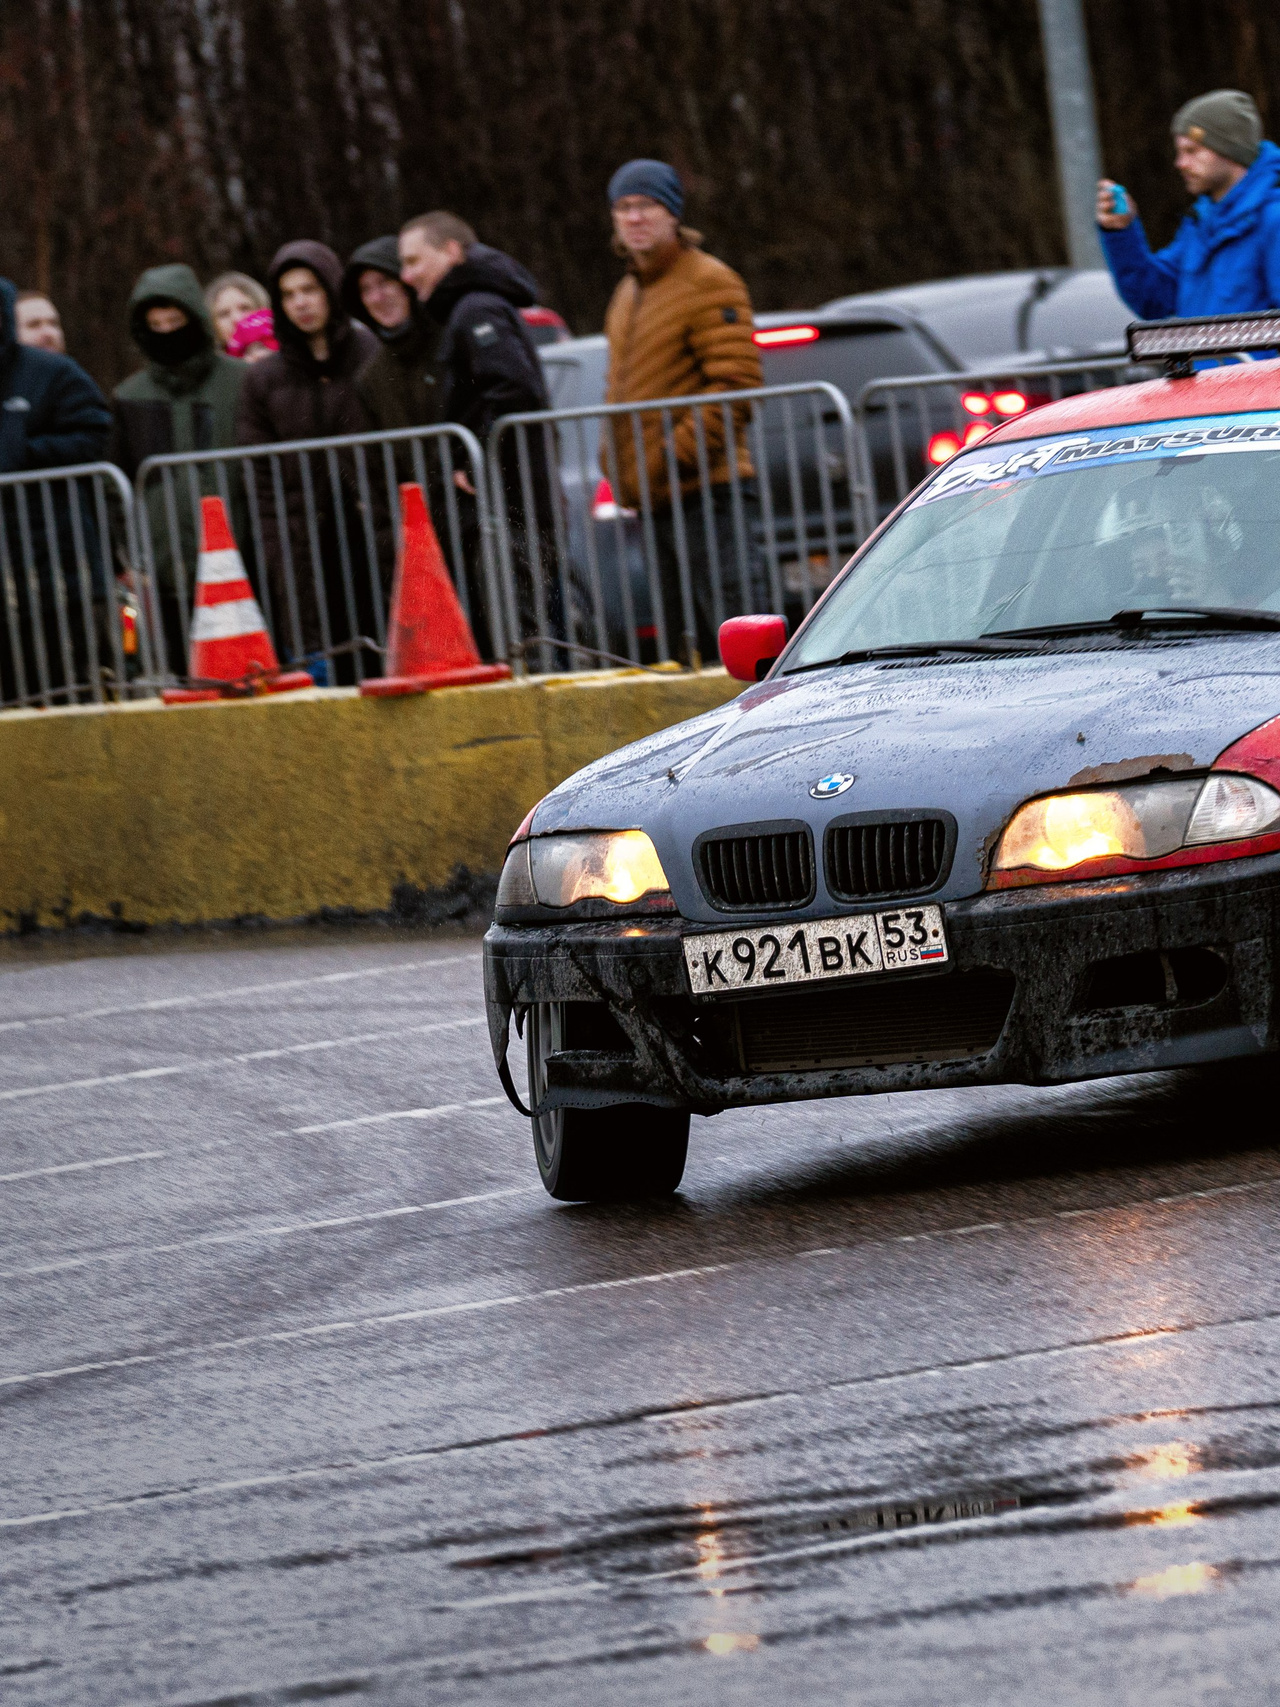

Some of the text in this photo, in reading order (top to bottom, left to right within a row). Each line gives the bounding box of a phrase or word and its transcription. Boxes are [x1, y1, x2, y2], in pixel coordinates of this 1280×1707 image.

[702, 911, 928, 985] К921ВК 53
[886, 949, 919, 964] RUS
